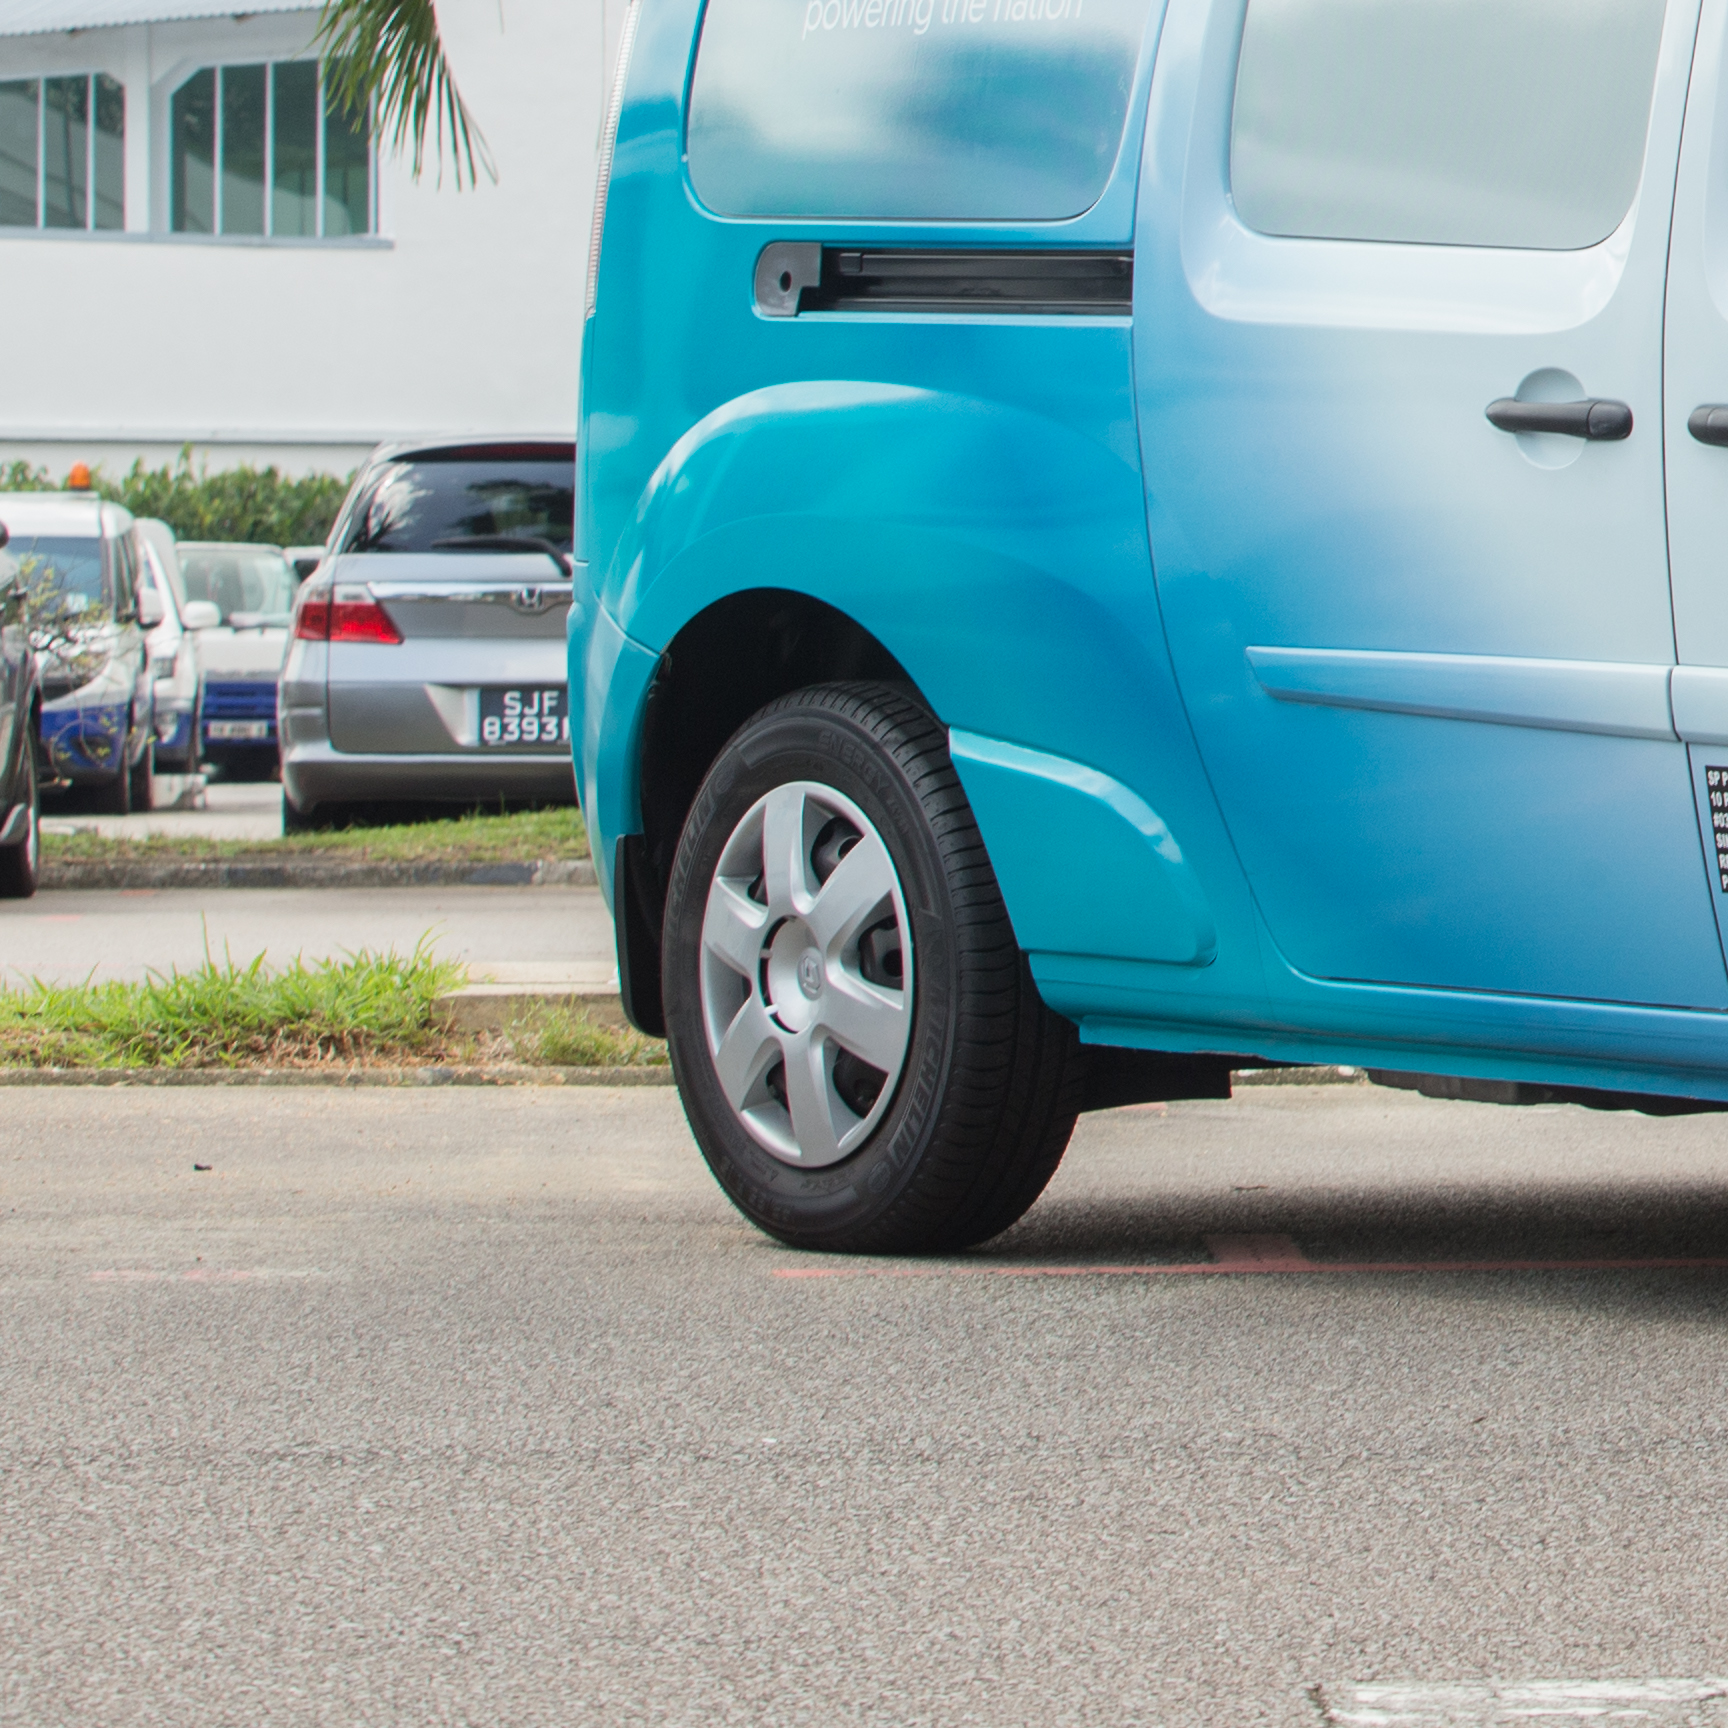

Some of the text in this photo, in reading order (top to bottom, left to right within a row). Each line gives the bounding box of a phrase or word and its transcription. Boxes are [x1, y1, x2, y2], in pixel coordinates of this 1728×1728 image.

[503, 690, 559, 716] SJF
[1708, 770, 1720, 786] SP
[1710, 791, 1723, 807] 10
